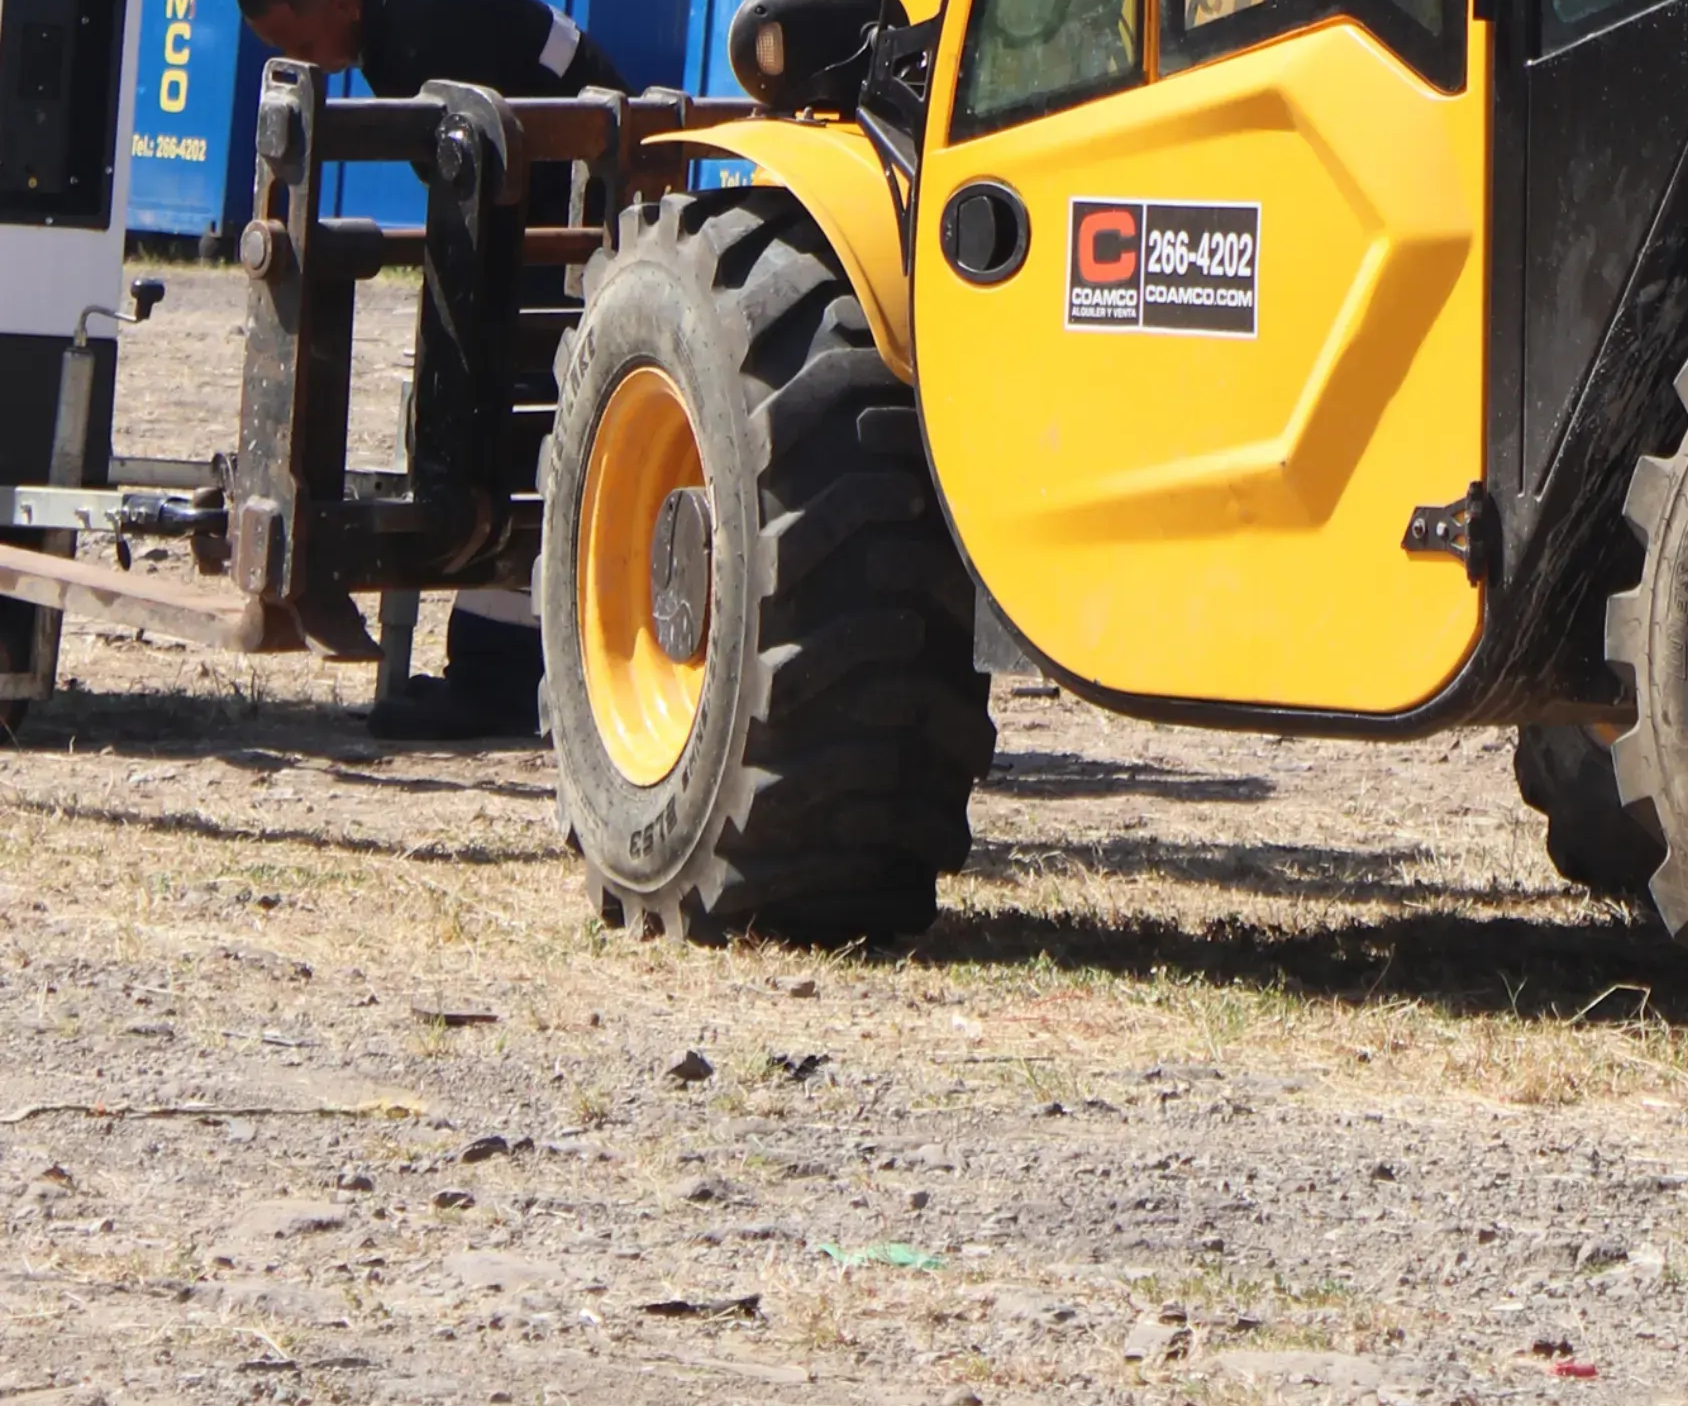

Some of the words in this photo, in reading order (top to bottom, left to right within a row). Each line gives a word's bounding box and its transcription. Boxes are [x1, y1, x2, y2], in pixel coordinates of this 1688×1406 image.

[155, 134, 207, 162] 266-4202
[1078, 208, 1136, 284] C
[1147, 230, 1253, 278] 266-4202
[1071, 287, 1138, 307] COAMCO
[1145, 284, 1253, 308] COAMCO.COM
[1071, 306, 1106, 318] ALQUILER
[1106, 307, 1114, 318] Y
[1113, 307, 1137, 319] VENTA
